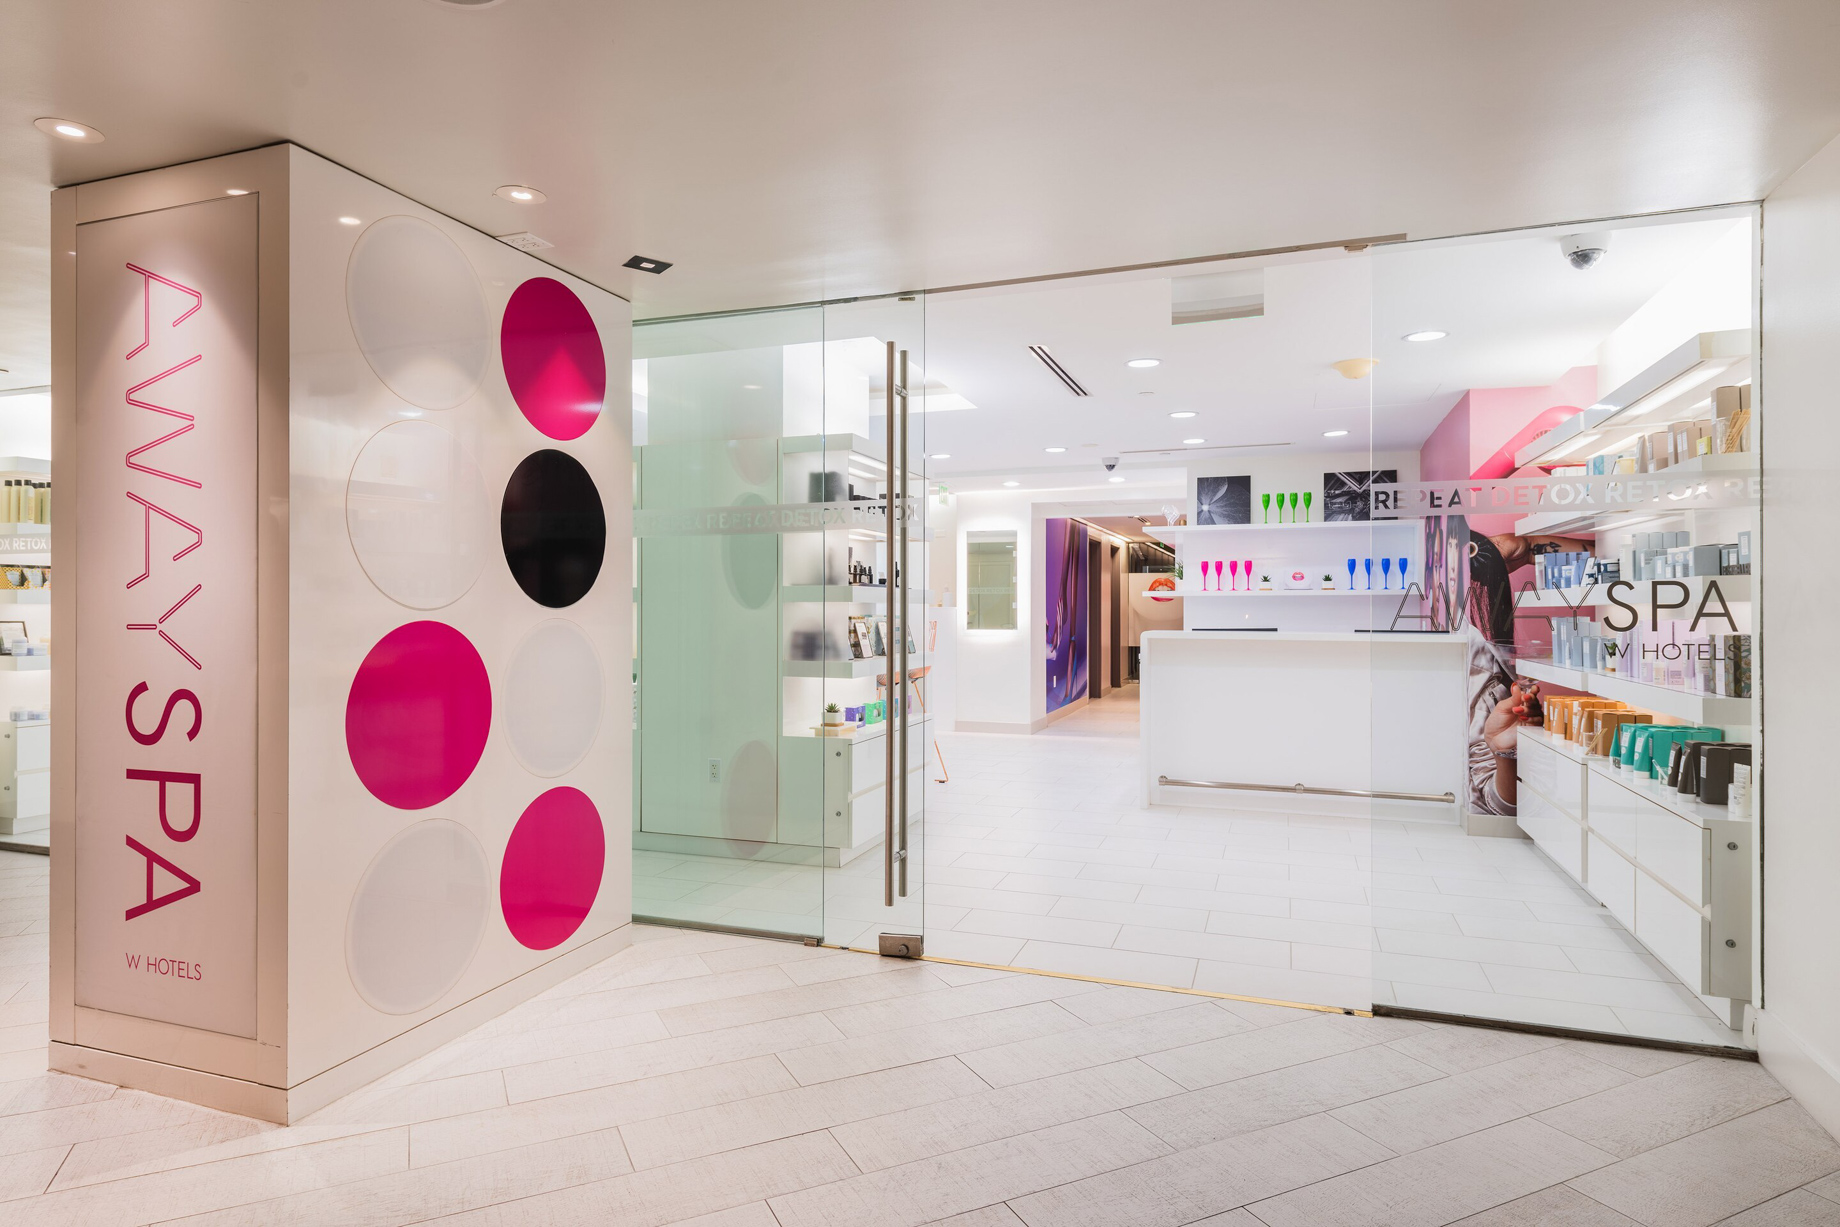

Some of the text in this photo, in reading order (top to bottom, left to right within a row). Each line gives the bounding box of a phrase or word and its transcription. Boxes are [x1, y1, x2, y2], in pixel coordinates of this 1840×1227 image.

[1374, 486, 1482, 511] REPEAT
[1491, 482, 1596, 508] DETOX
[1604, 479, 1713, 504] RETOX
[780, 507, 846, 527] DETOX
[13, 537, 47, 550] RETOX
[1604, 642, 1740, 660] W HOTELS
[126, 952, 202, 981] W HOTELS
